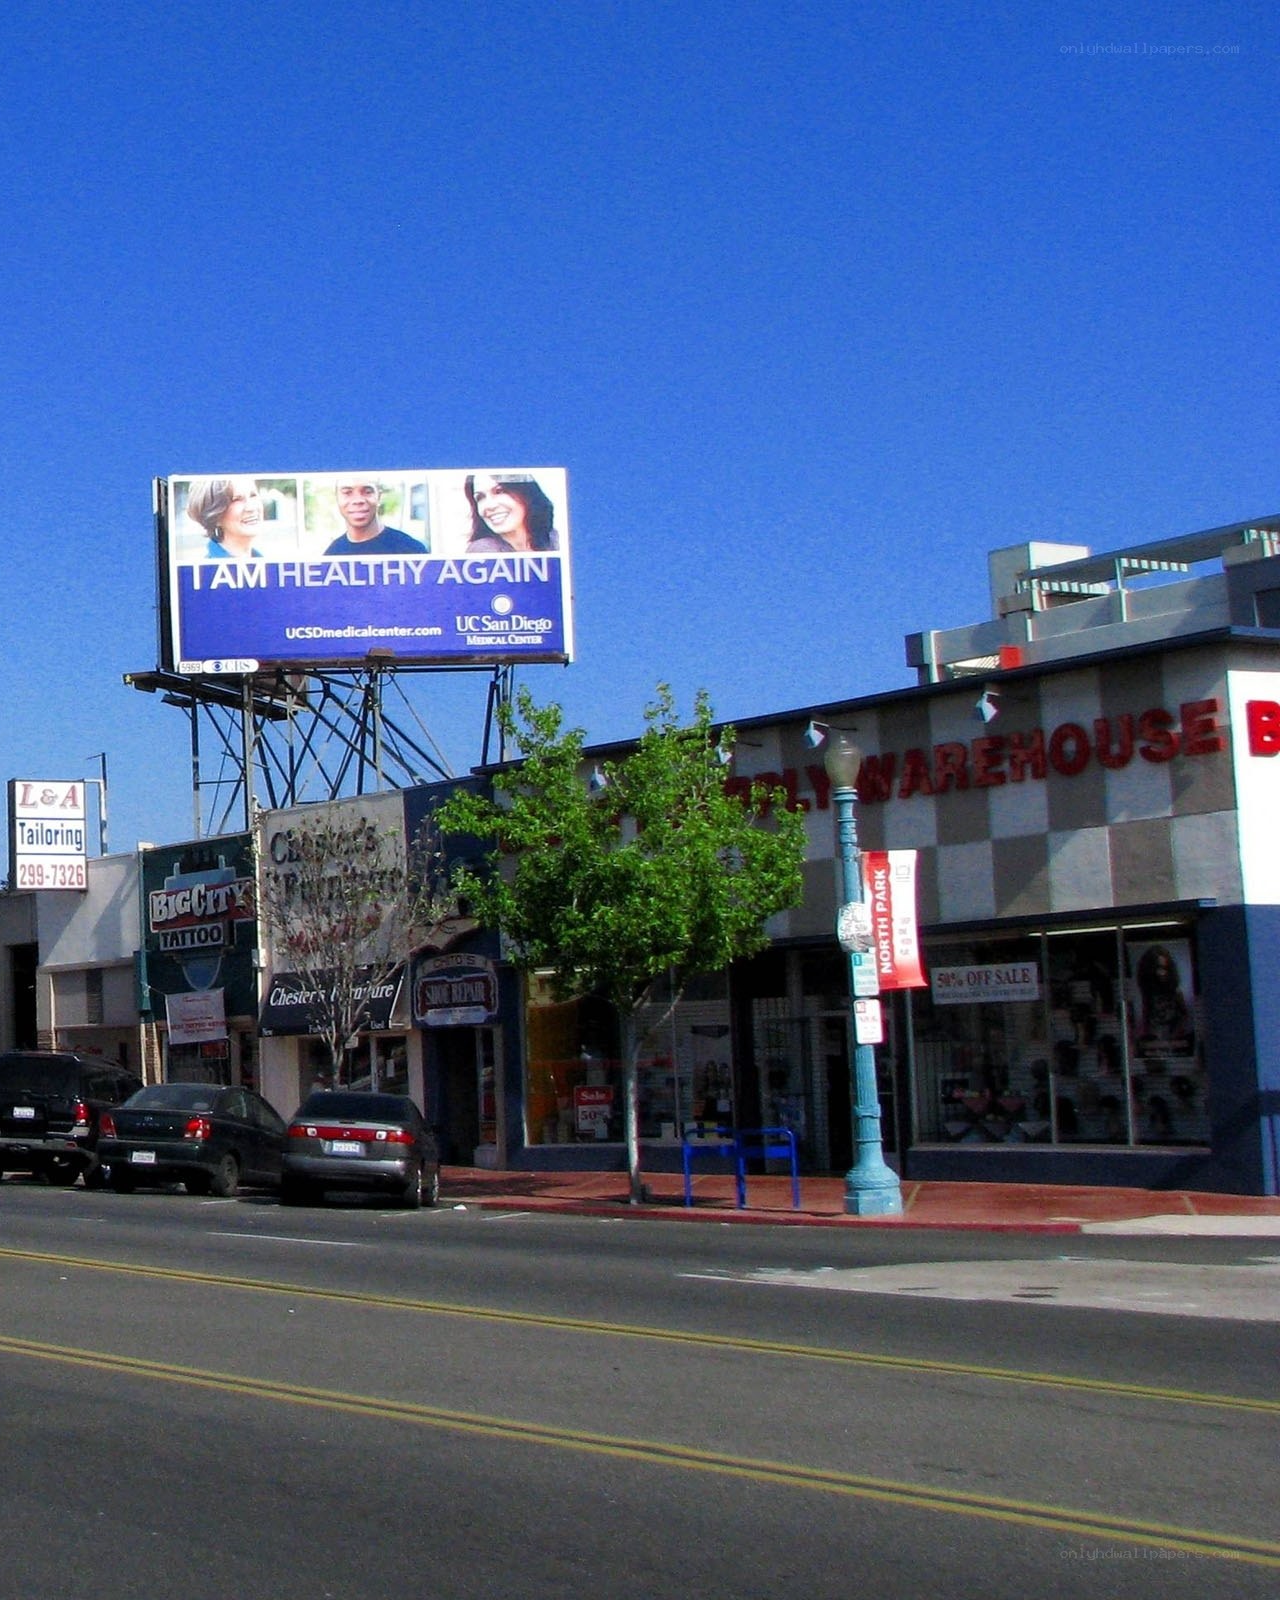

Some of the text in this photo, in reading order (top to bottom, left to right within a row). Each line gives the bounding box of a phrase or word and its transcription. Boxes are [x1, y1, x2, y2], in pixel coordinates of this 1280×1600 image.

[192, 557, 549, 590] I AM HEALTHY AGAIN
[285, 625, 442, 641] UCSDmedicalcenter.com
[456, 615, 552, 634] UC San Diego
[508, 635, 543, 645] CENTER
[856, 699, 1223, 805] WAREHOUSE
[19, 783, 81, 809] L & A
[18, 822, 83, 851] Tailoring
[19, 864, 84, 886] 299-7326
[873, 869, 892, 974] NORTH PARK
[161, 925, 222, 948] TATTOO
[966, 969, 992, 986] OFF
[995, 967, 1030, 985] SALE
[270, 986, 326, 1006] Chester's
